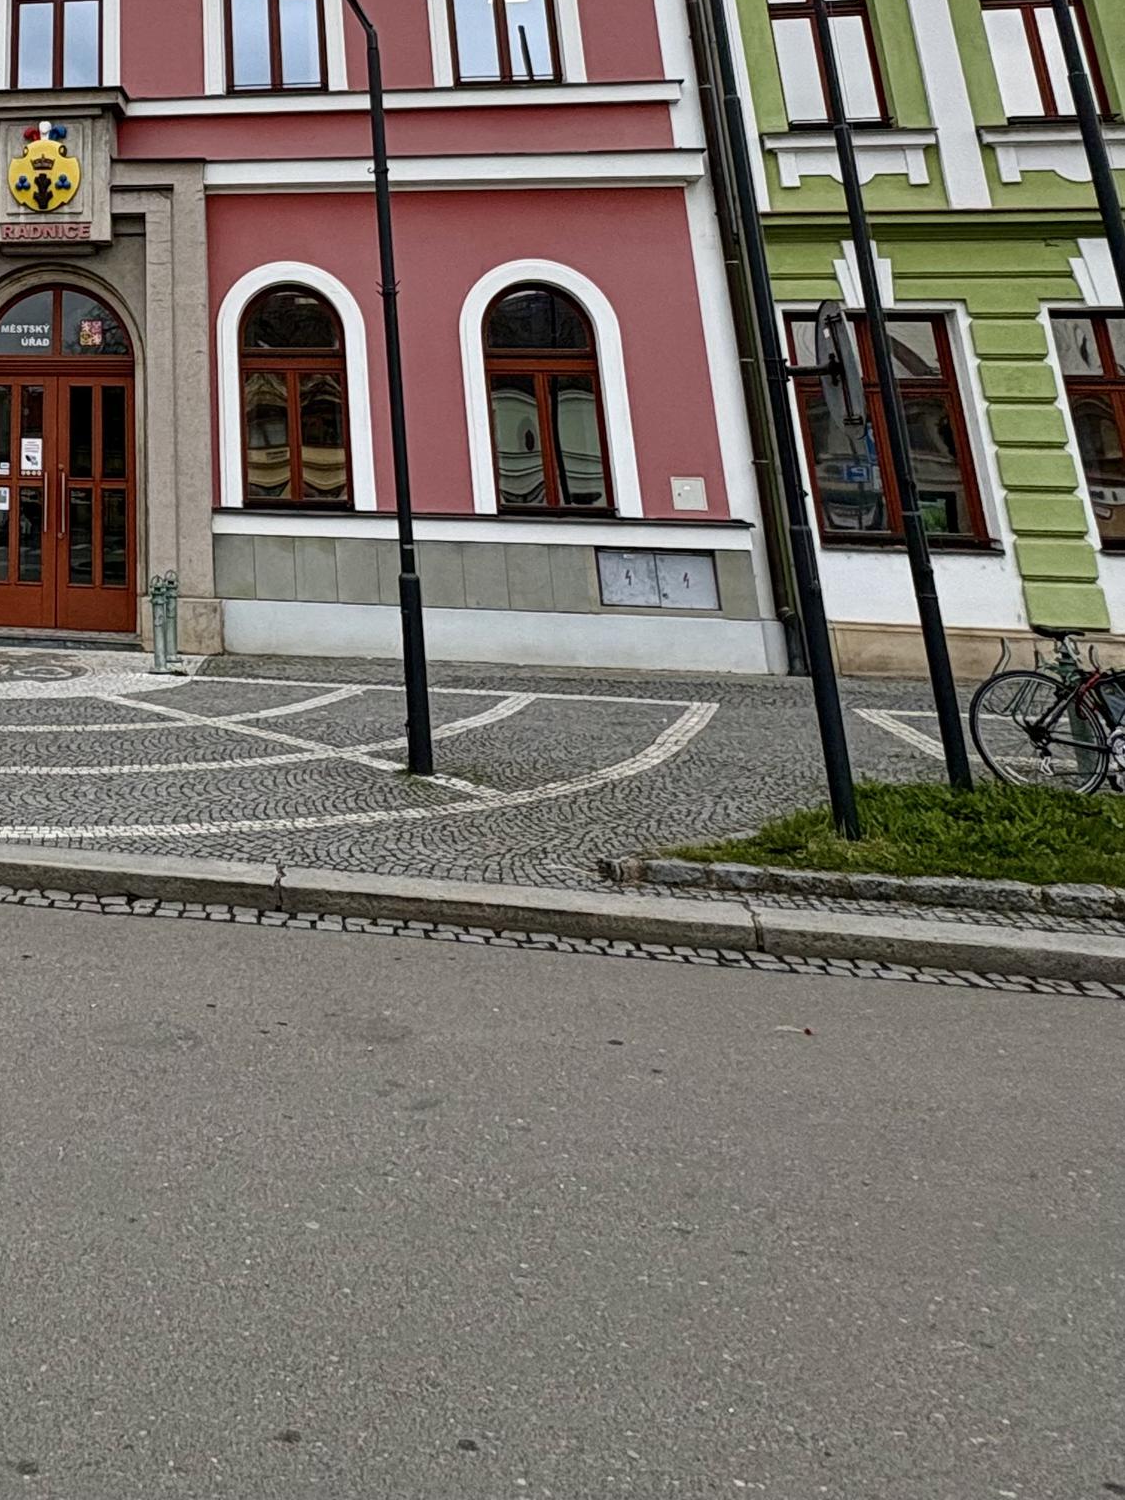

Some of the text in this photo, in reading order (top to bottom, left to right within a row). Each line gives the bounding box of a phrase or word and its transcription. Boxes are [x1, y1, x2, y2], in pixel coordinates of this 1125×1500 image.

[1, 223, 92, 240] RADNICE
[0, 323, 50, 334] MĚSTSKÝ
[21, 336, 50, 347] ÚŘAD
